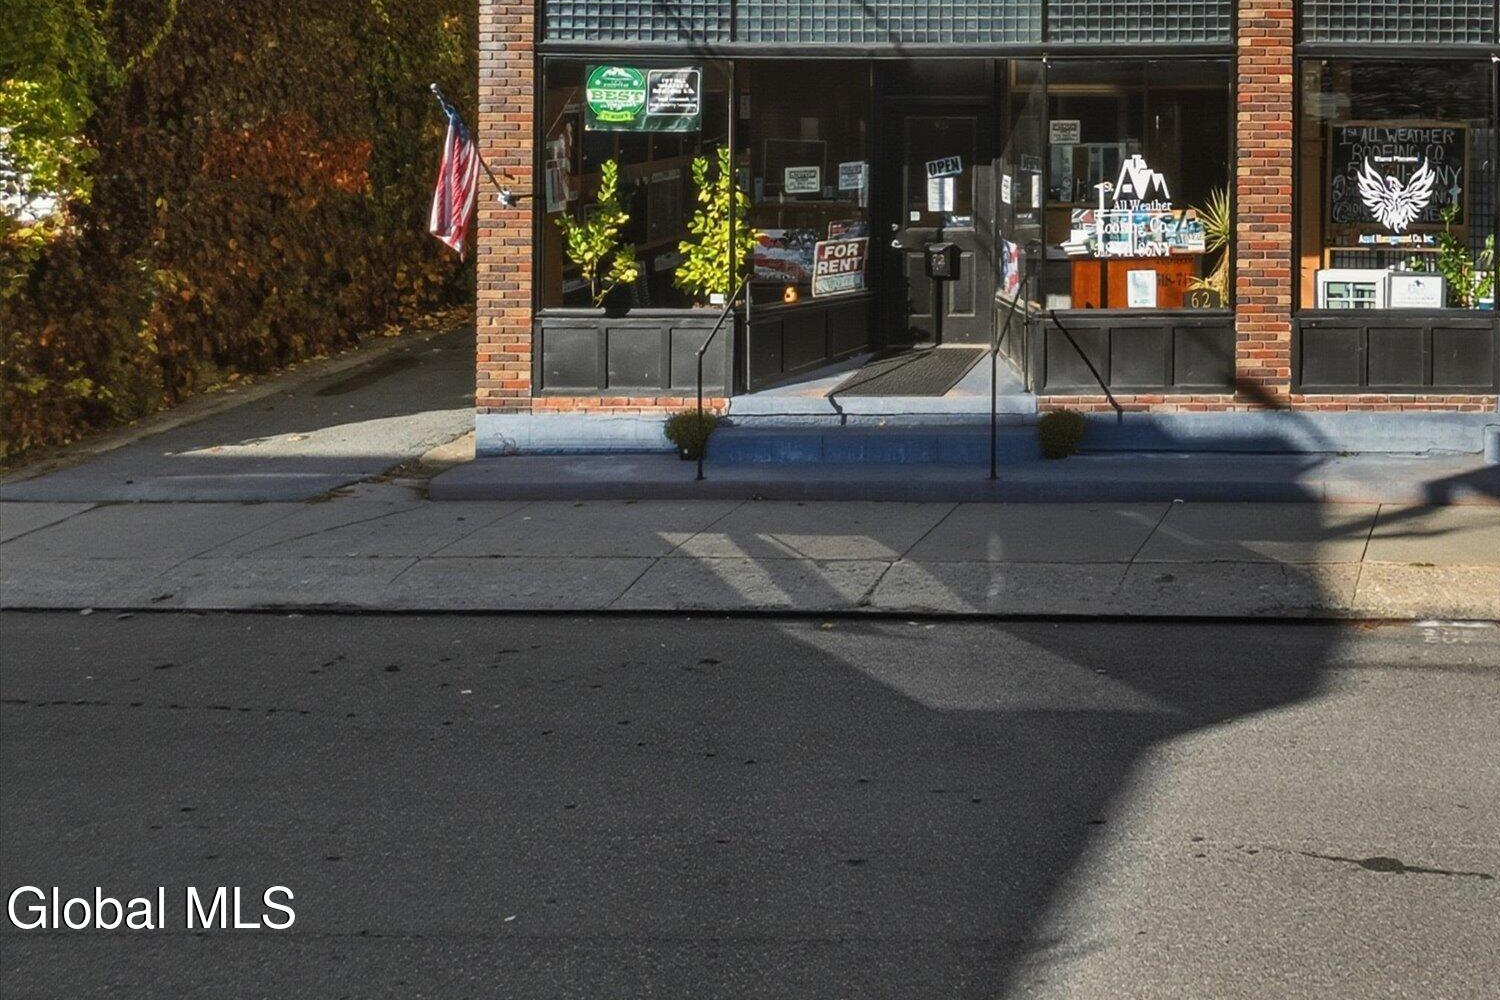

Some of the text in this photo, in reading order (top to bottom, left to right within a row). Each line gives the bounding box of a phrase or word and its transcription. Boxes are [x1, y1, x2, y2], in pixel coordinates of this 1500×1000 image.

[591, 89, 644, 102] BEST
[1360, 127, 1383, 145] ALL
[1385, 127, 1455, 143] WEATHER
[928, 159, 960, 176] OPEN
[1113, 198, 1172, 211] All Weather
[823, 242, 859, 259] FOR
[817, 257, 862, 275] RENT
[1191, 291, 1211, 309] 62
